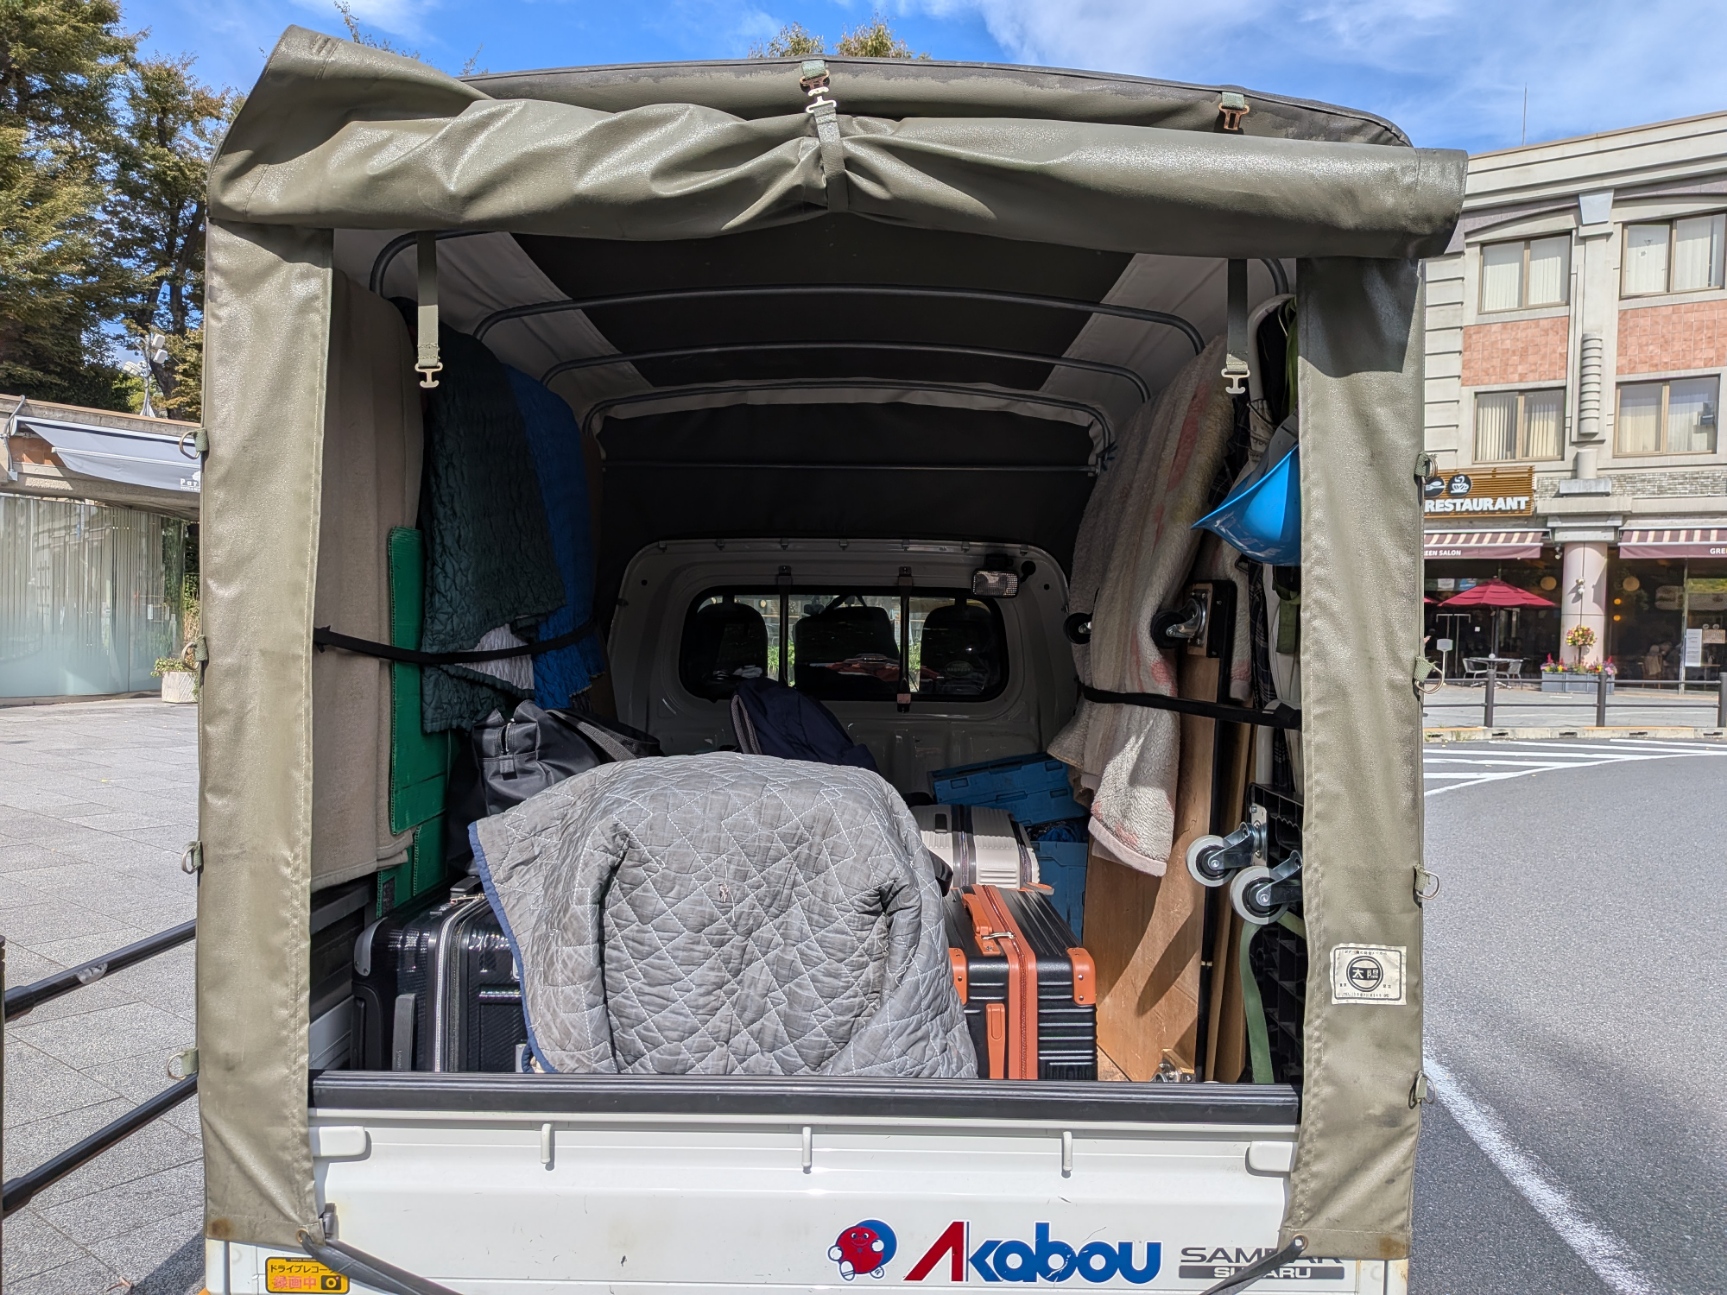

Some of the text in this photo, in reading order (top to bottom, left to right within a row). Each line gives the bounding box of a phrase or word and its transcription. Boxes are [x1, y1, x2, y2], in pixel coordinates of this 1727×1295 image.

[1424, 497, 1529, 512] RESTAURANT
[903, 1221, 1162, 1284] Akabou
[270, 1264, 334, 1274] ドライブレコー
[273, 1275, 317, 1290] 録画中
